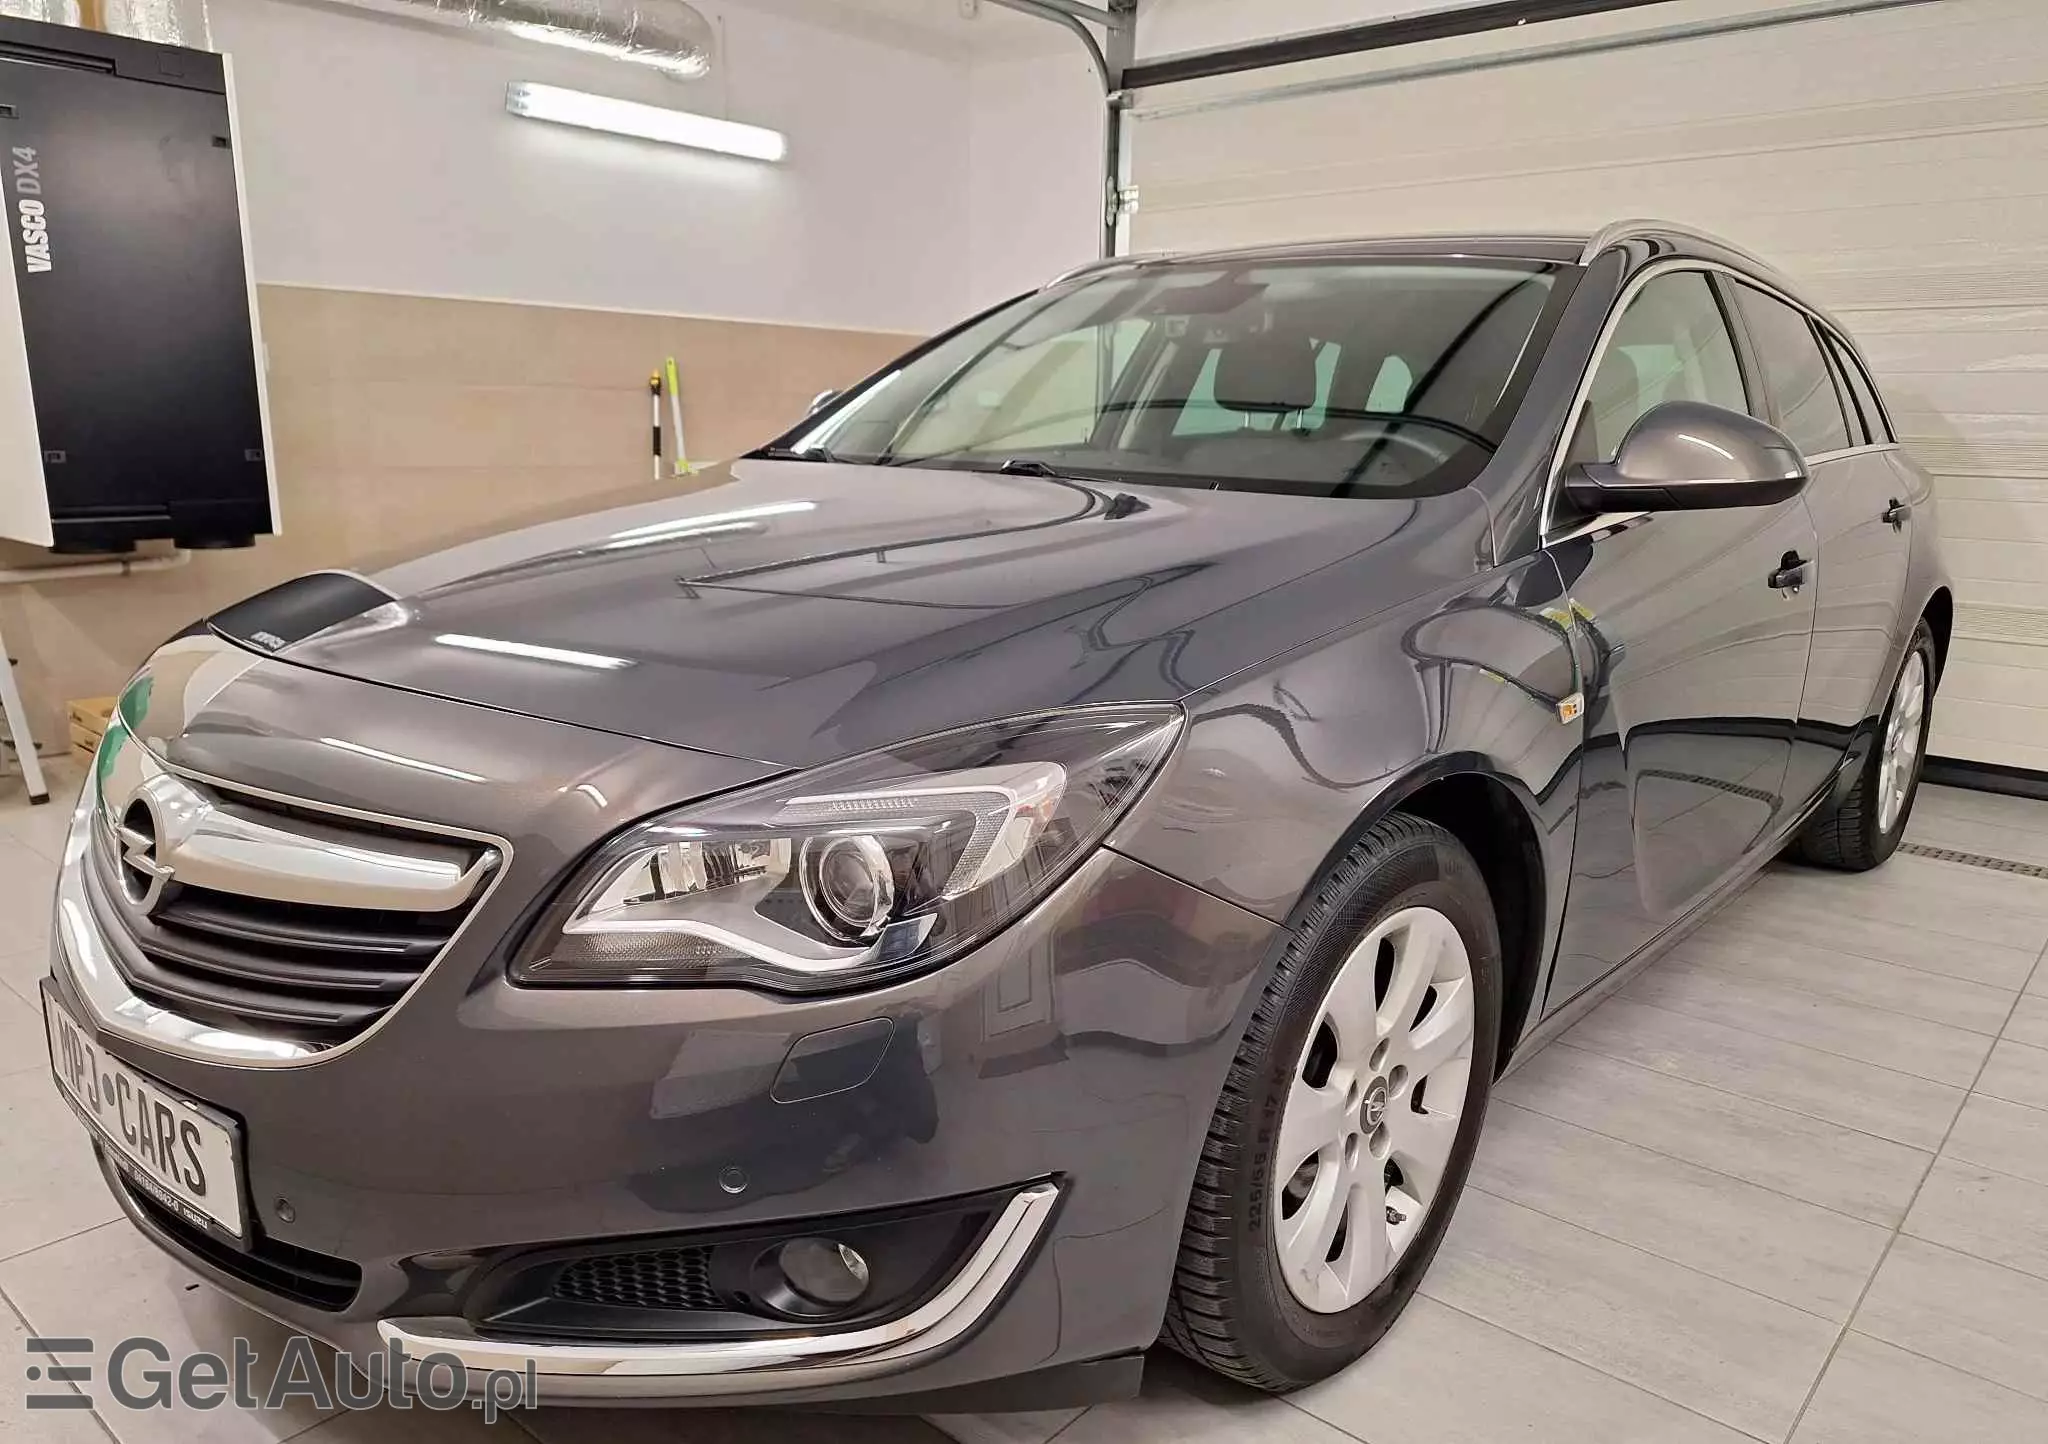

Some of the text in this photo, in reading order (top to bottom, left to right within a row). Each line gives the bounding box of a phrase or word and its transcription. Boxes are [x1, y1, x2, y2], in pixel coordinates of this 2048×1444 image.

[12, 146, 52, 272] VASCO DX4
[115, 1071, 206, 1196] CARS
